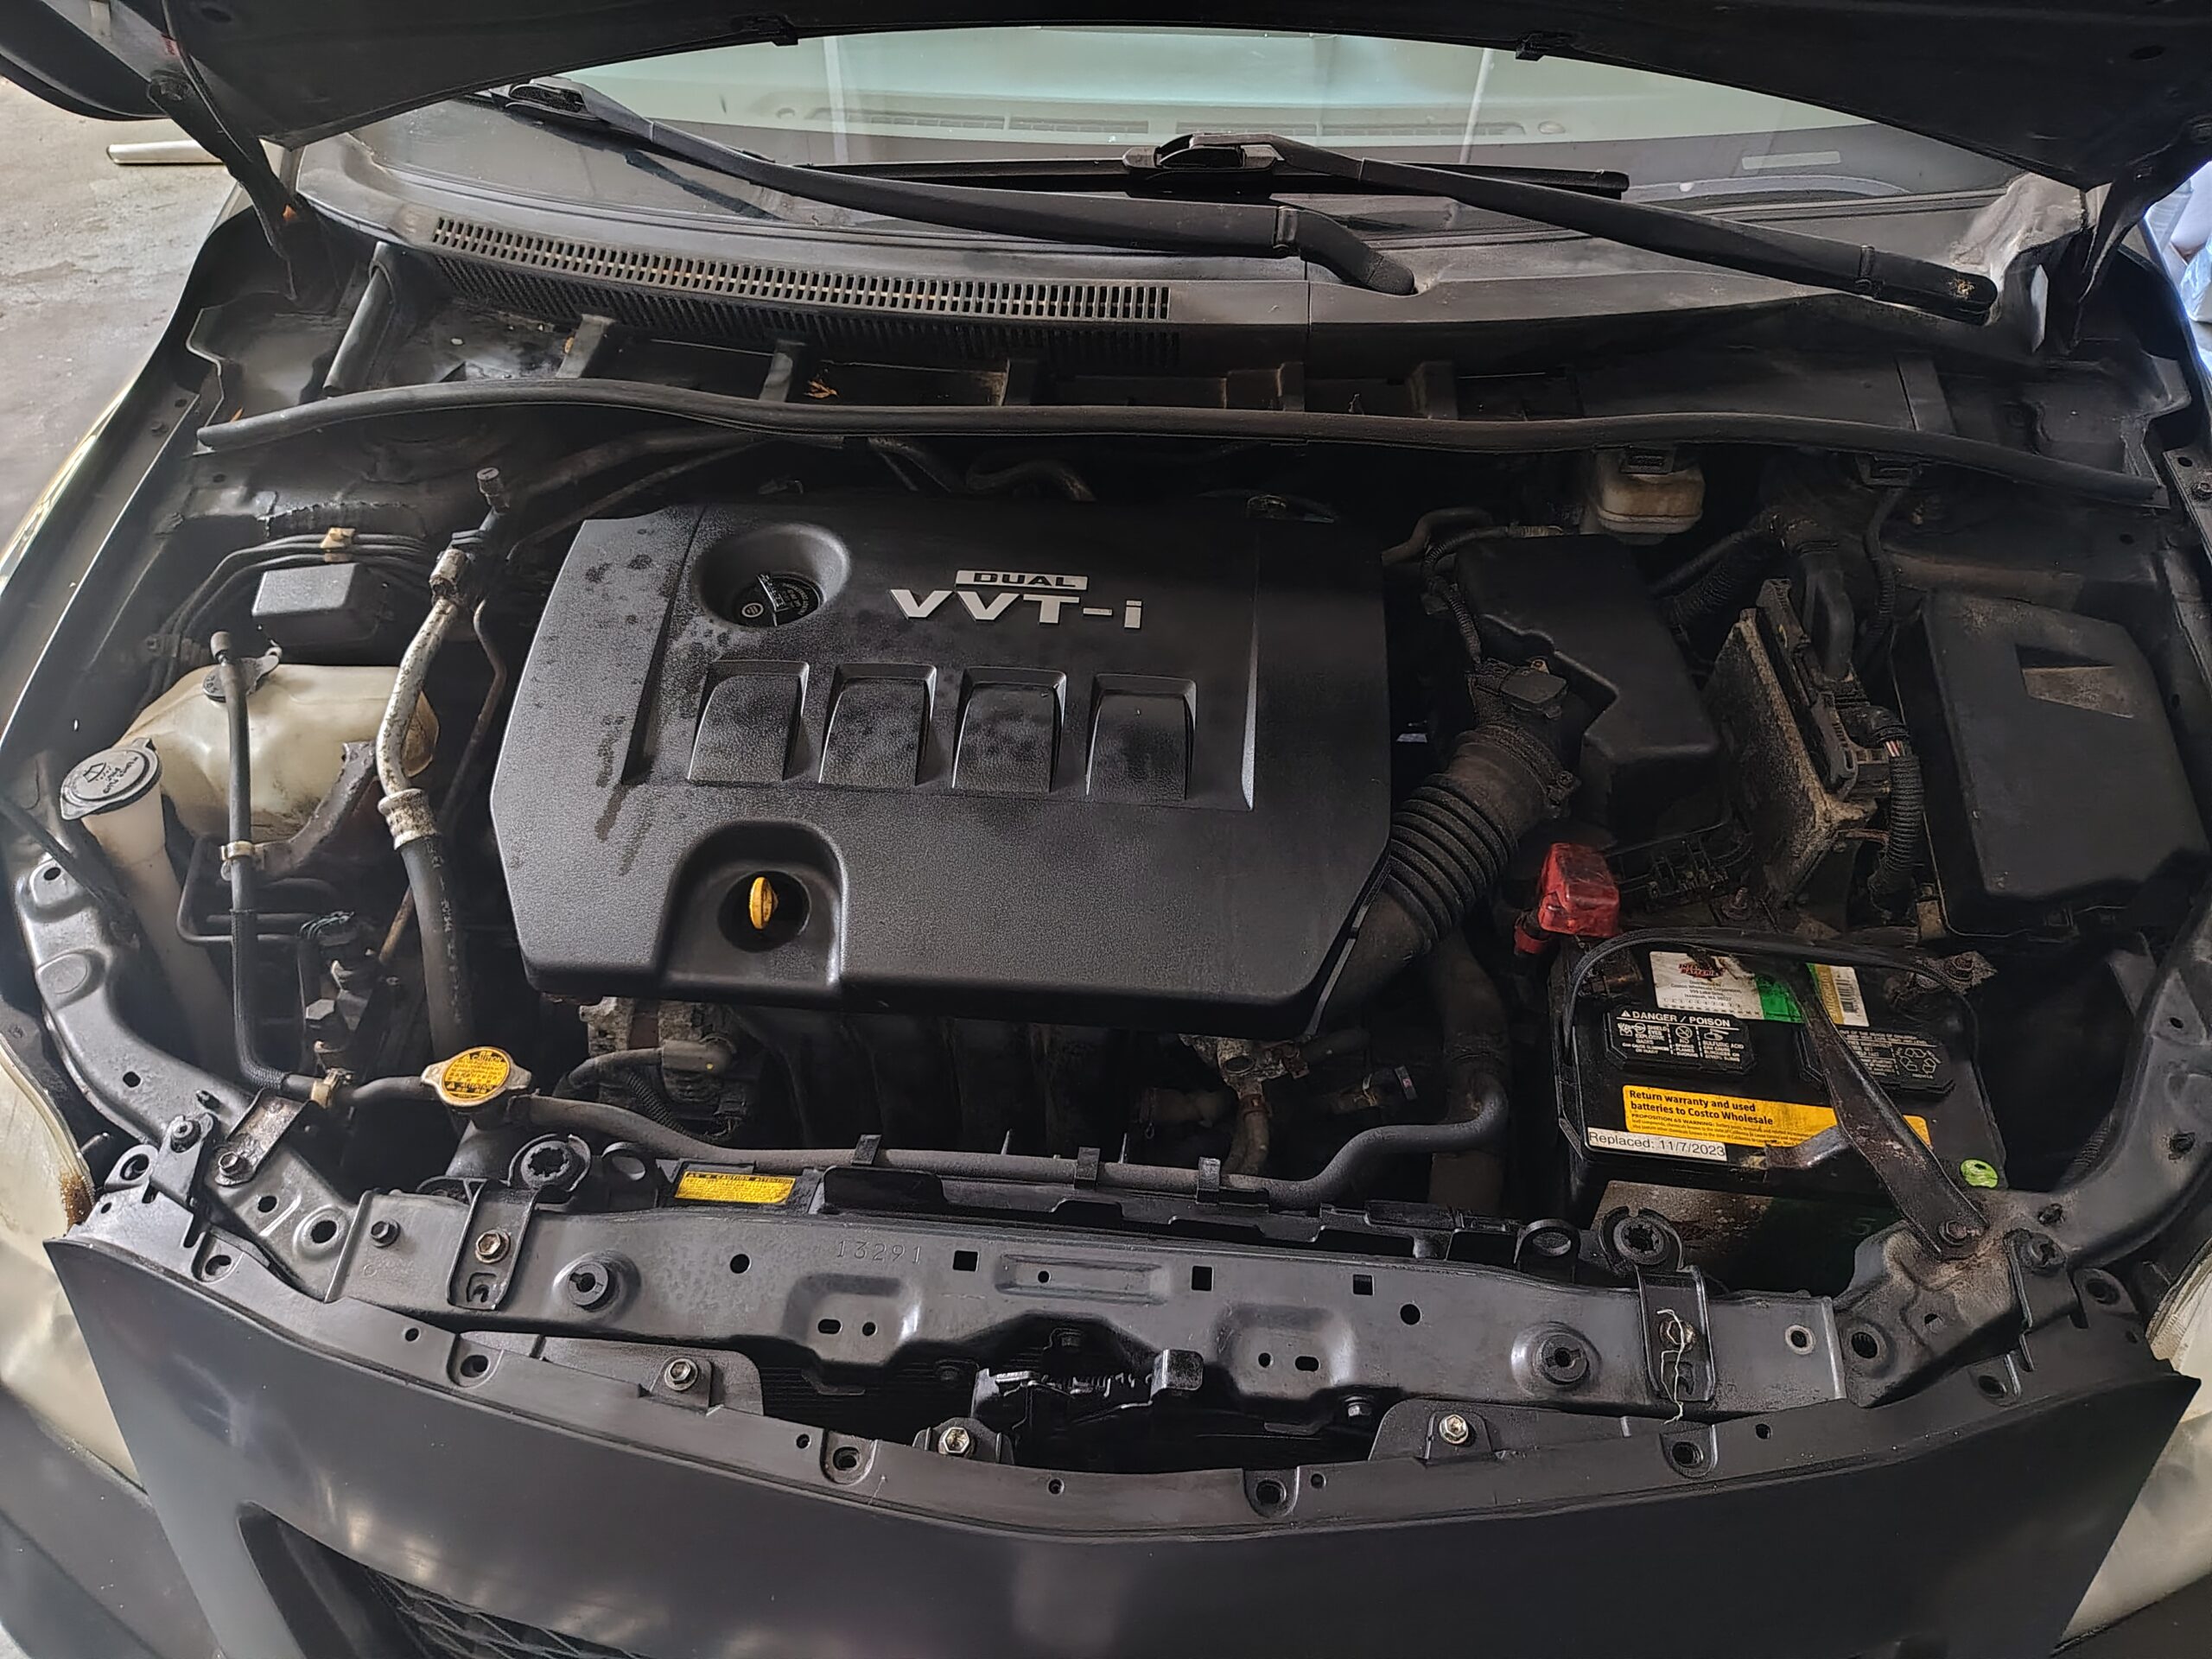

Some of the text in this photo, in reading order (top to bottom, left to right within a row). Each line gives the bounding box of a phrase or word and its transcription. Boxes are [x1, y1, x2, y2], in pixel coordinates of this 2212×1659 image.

[974, 573, 1076, 587] DUAL
[890, 589, 1142, 629] VVT-i
[1632, 1011, 1677, 1022] DANGER
[1689, 1016, 1730, 1027] POISON
[1630, 1090, 1756, 1112] Return warranty and used
[1630, 1101, 1773, 1125] batteries to Costco Wholesale
[1589, 1131, 1725, 1157] Replaced: 11/7/2023
[836, 1239, 924, 1265] 13291
